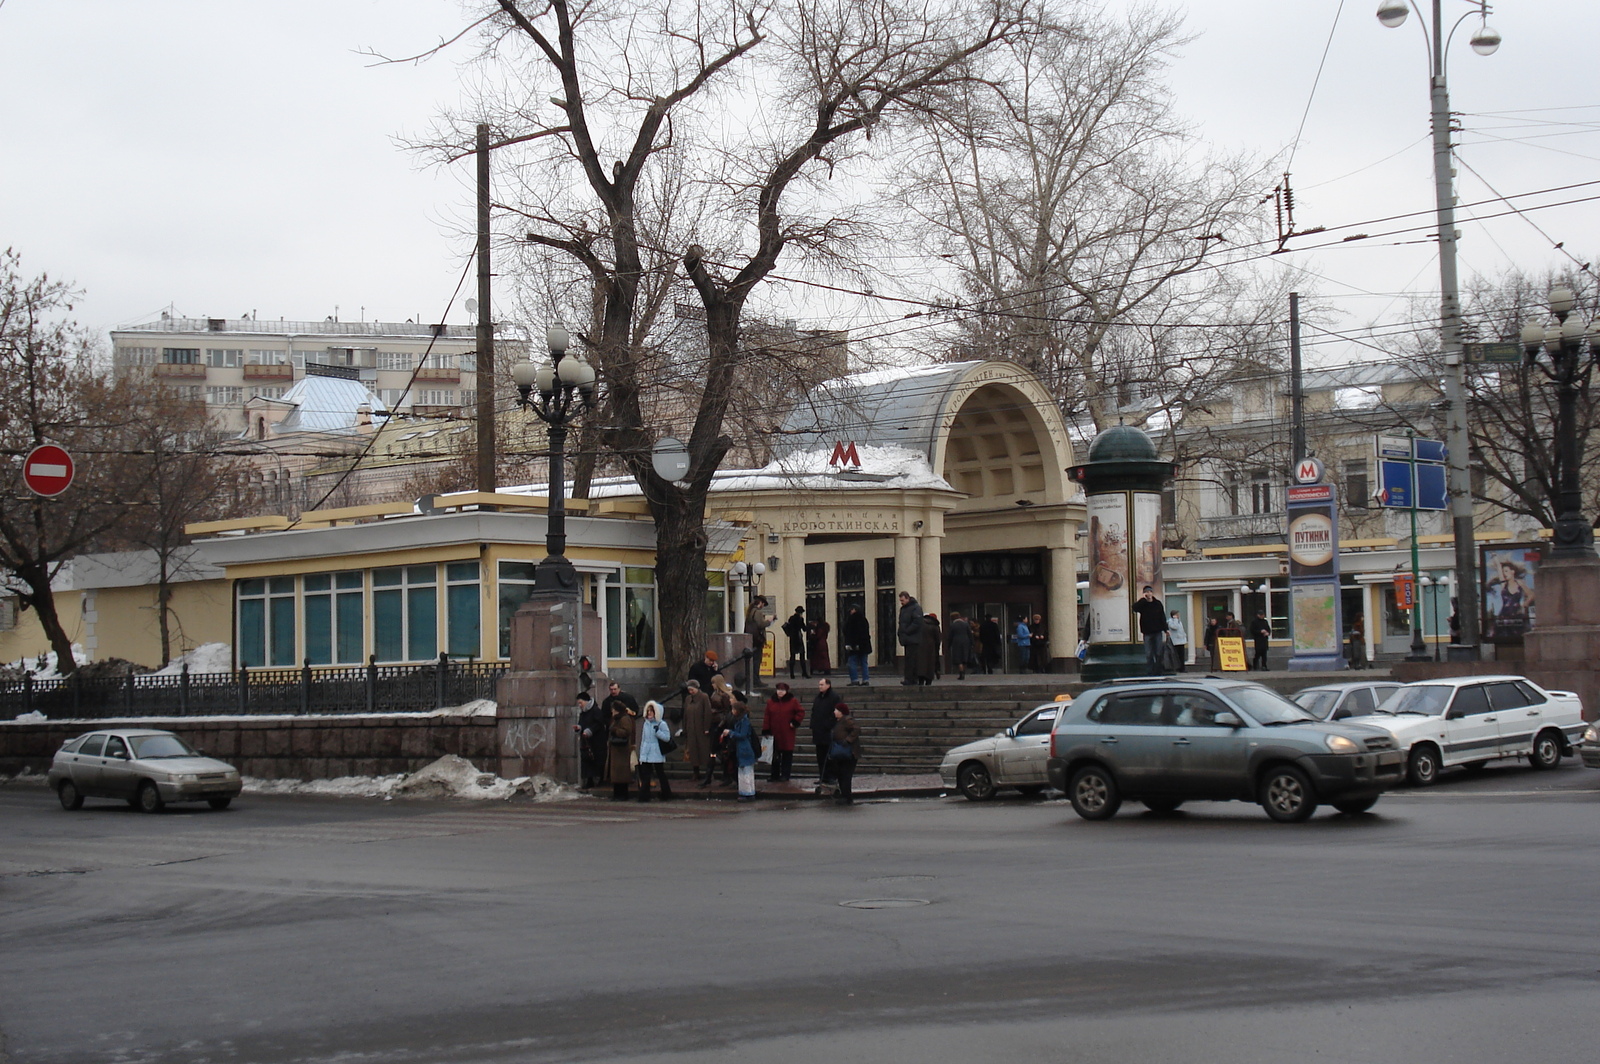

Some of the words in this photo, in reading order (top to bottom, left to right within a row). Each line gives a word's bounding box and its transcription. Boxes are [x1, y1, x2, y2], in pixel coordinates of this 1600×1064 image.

[829, 441, 861, 466] М
[1300, 463, 1315, 479] М
[783, 521, 899, 531] КРОПОТКИНСКАЯ
[1295, 530, 1329, 543] ПУТИНКИ
